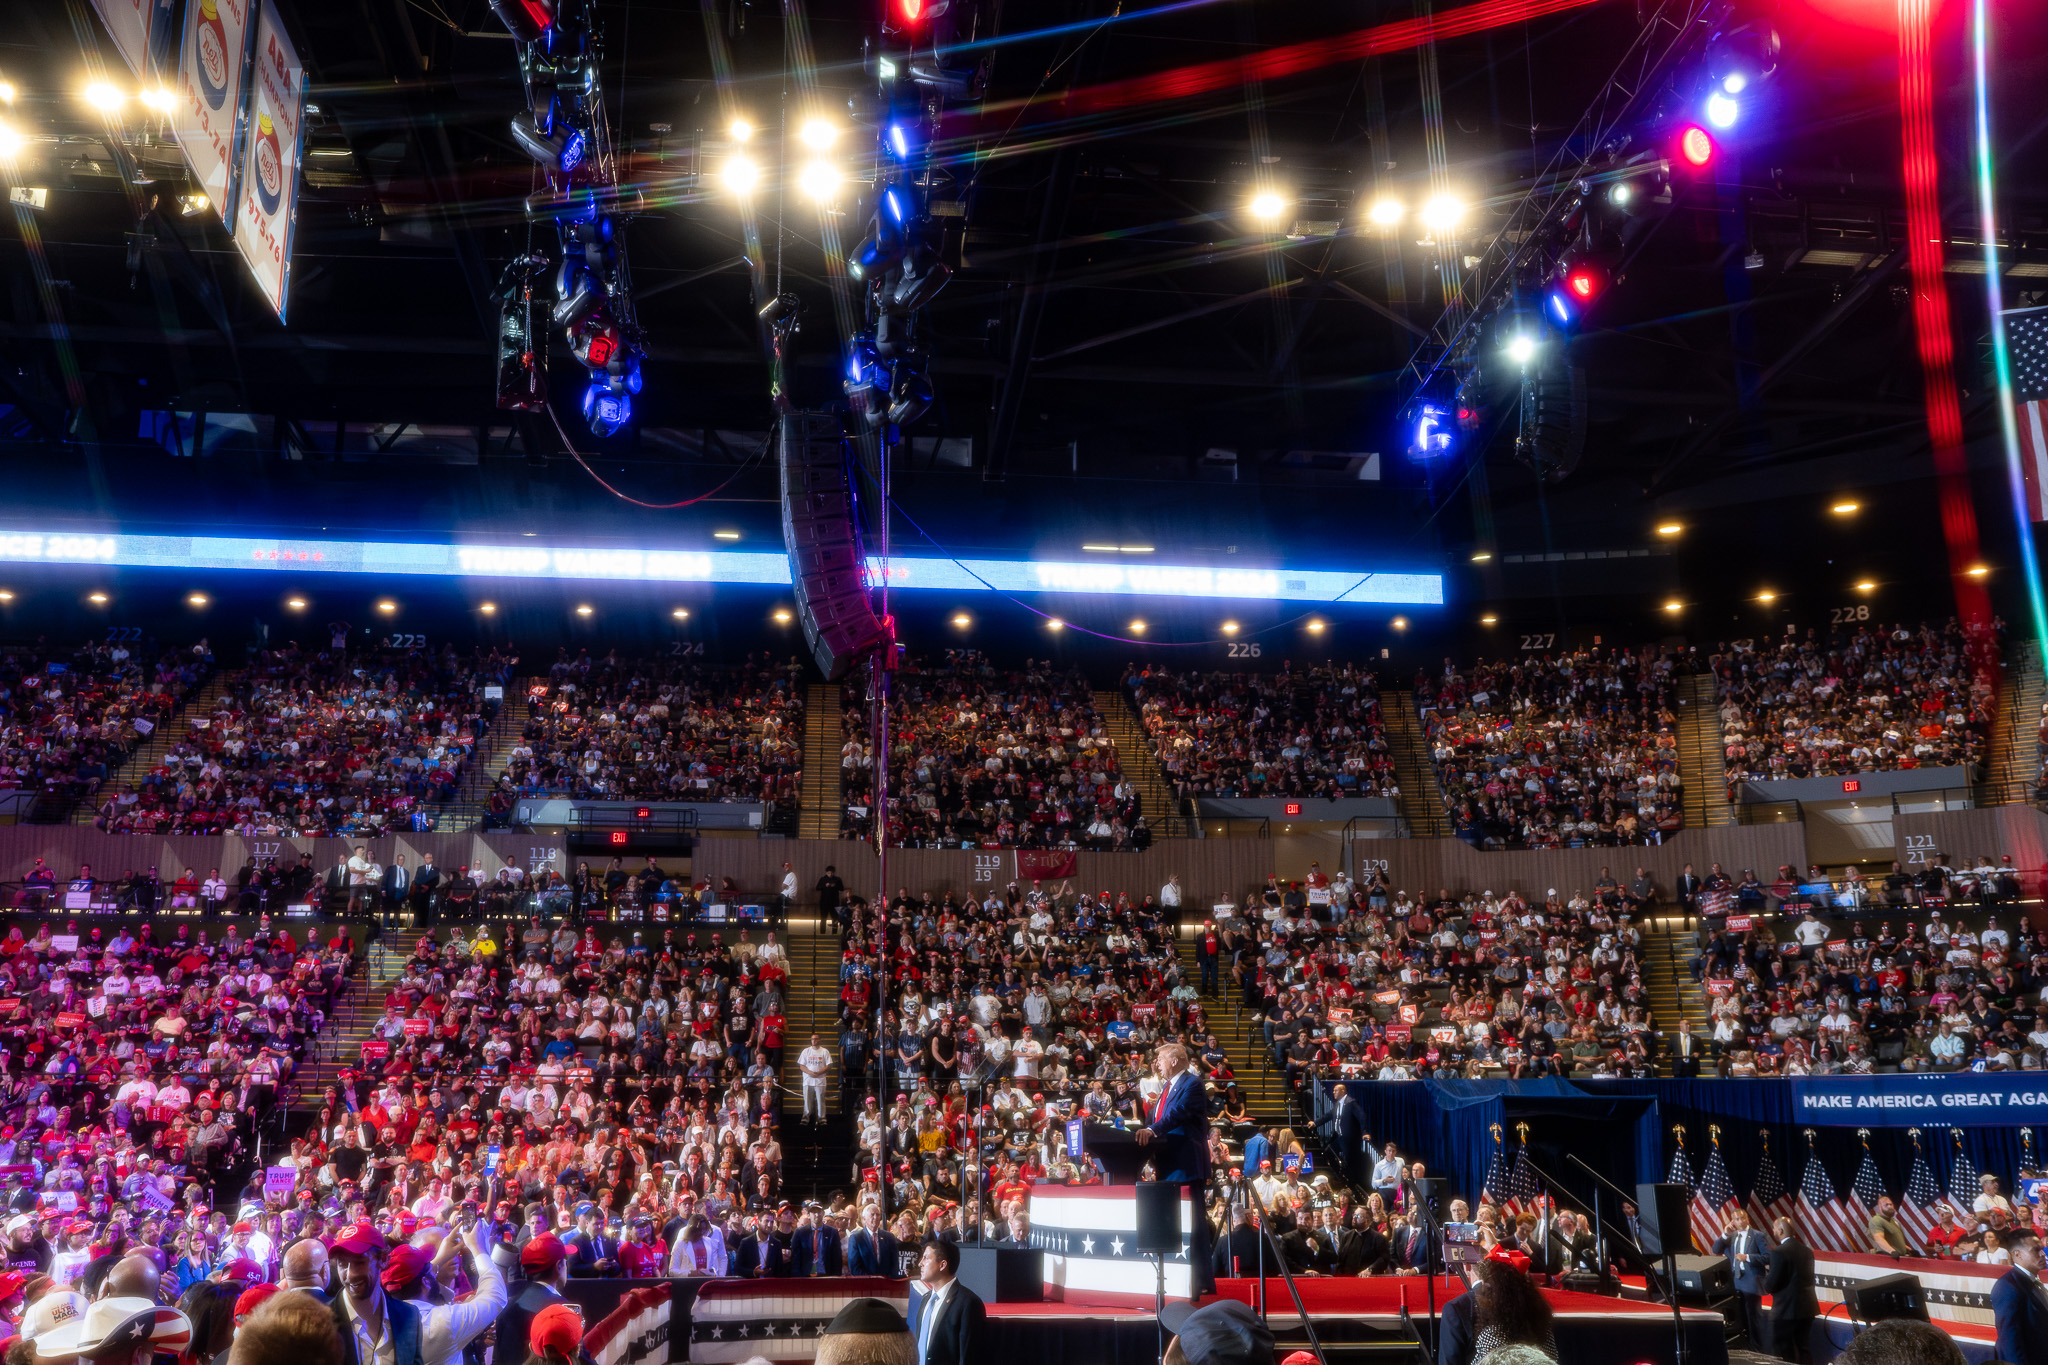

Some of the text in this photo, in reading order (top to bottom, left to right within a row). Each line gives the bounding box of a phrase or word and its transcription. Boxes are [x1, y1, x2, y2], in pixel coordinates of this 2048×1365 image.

[268, 33, 292, 98] ABA
[248, 197, 281, 264] 975-76
[46, 537, 116, 558] 2024
[458, 549, 712, 577] TRUMP VANCE 2024
[1036, 565, 1124, 588] TRUMP
[1128, 567, 1212, 591] VANCE
[1831, 604, 1870, 624] 228
[107, 626, 143, 642] 222
[392, 633, 427, 649] 223
[1520, 632, 1556, 651] 227
[671, 641, 705, 656] 224
[1227, 642, 1262, 658] 226
[24, 677, 40, 687] 47
[531, 686, 546, 695] 47
[1844, 781, 1858, 791] EXIT
[1287, 804, 1299, 814] EXIT
[613, 832, 627, 843] EXIT
[1905, 835, 1936, 849] 121
[253, 842, 281, 855] 117
[529, 847, 556, 860] 118
[975, 855, 1001, 867] 119
[1907, 851, 1927, 864] 21
[1363, 859, 1388, 871] 120
[975, 870, 992, 882] 19
[1479, 931, 1496, 939] TRUMP
[1403, 1007, 1416, 1024] 47
[1435, 1031, 1453, 1042] 47
[1972, 1061, 1986, 1073] 47
[1803, 1091, 2048, 1108] MAKE AMERICA GREAT AGA
[144, 1191, 169, 1211] TRUMP
[51, 1305, 75, 1317] ULTRA
[53, 1309, 79, 1321] MAGA
